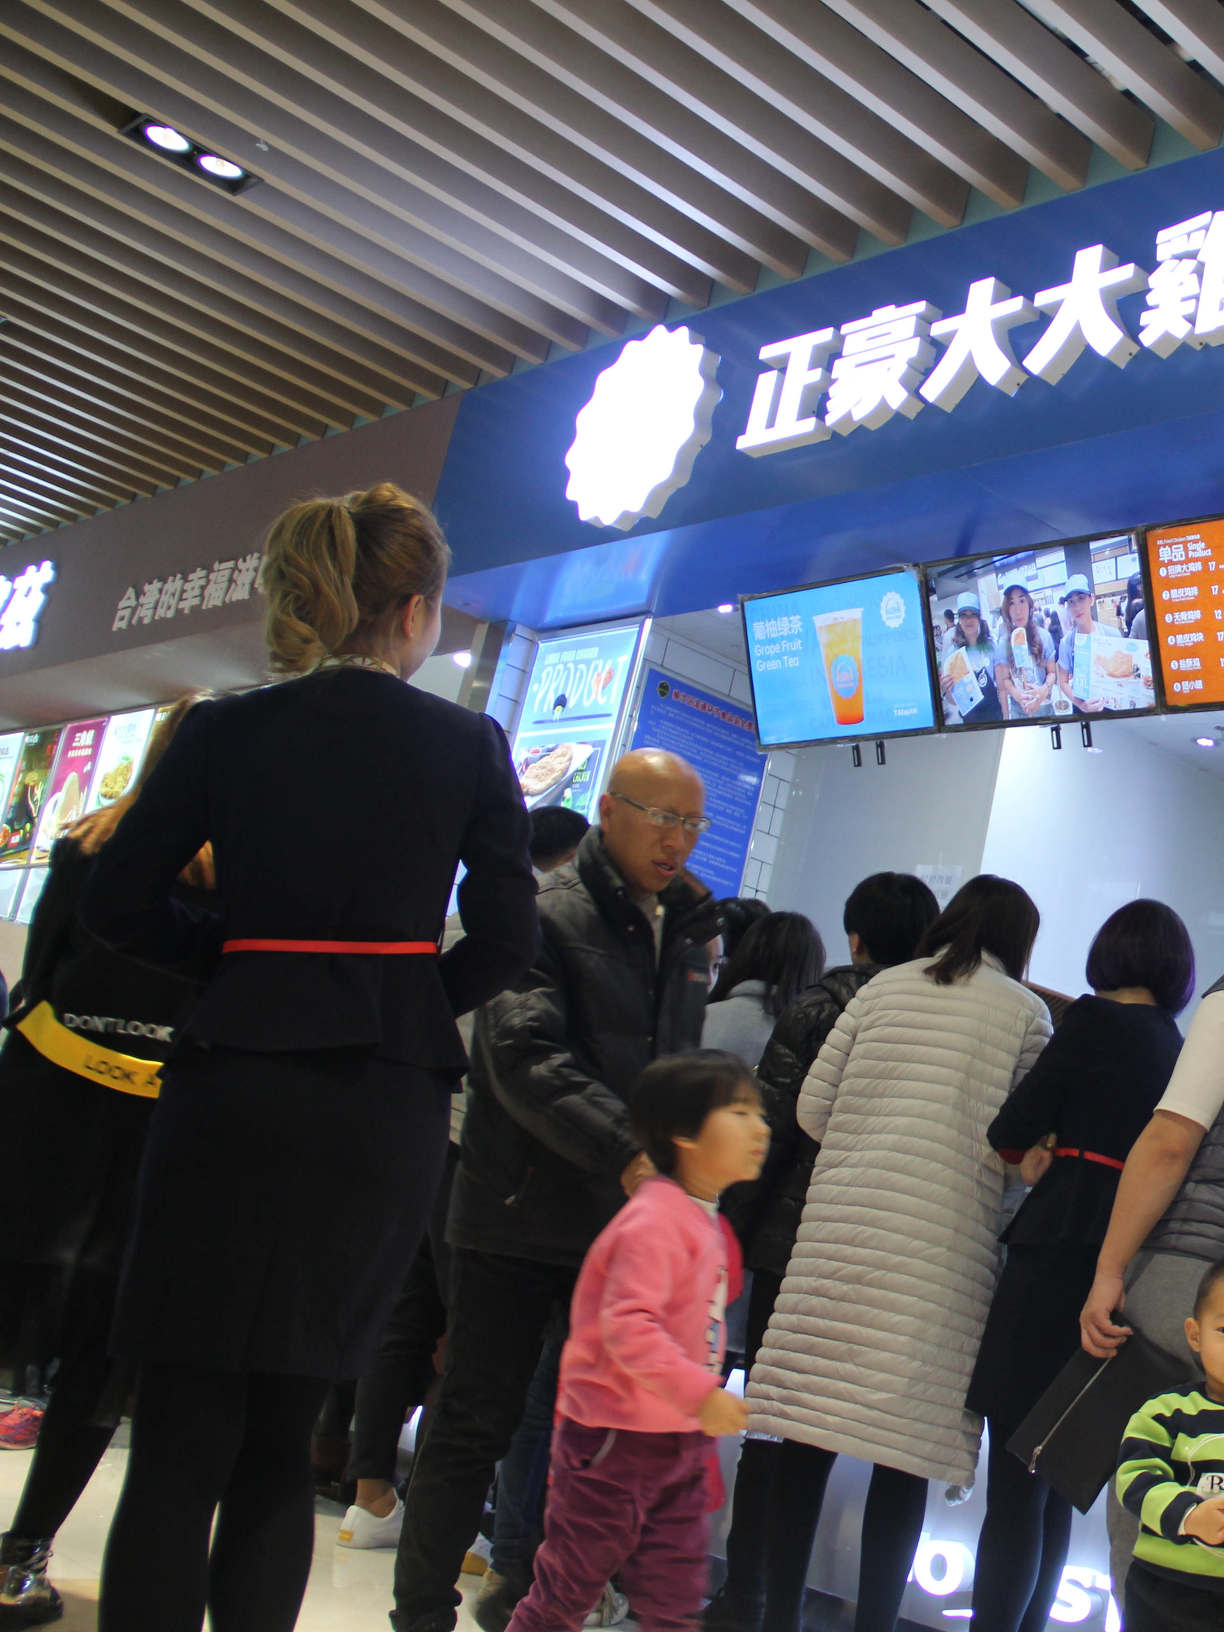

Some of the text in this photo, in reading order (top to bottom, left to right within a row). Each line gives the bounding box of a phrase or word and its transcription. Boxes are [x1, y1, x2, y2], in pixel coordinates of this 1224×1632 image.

[1187, 541, 1206, 552] Single
[1158, 544, 1186, 563] 单品
[1188, 549, 1212, 559] Product
[1208, 561, 1216, 572] 17
[112, 552, 268, 632] 台湾的幸福滋
[1211, 584, 1219, 595] 17
[1214, 608, 1223, 620] 12
[1216, 631, 1224, 642] 17
[781, 638, 803, 652] Fruit
[756, 654, 800, 672] Green Tea
